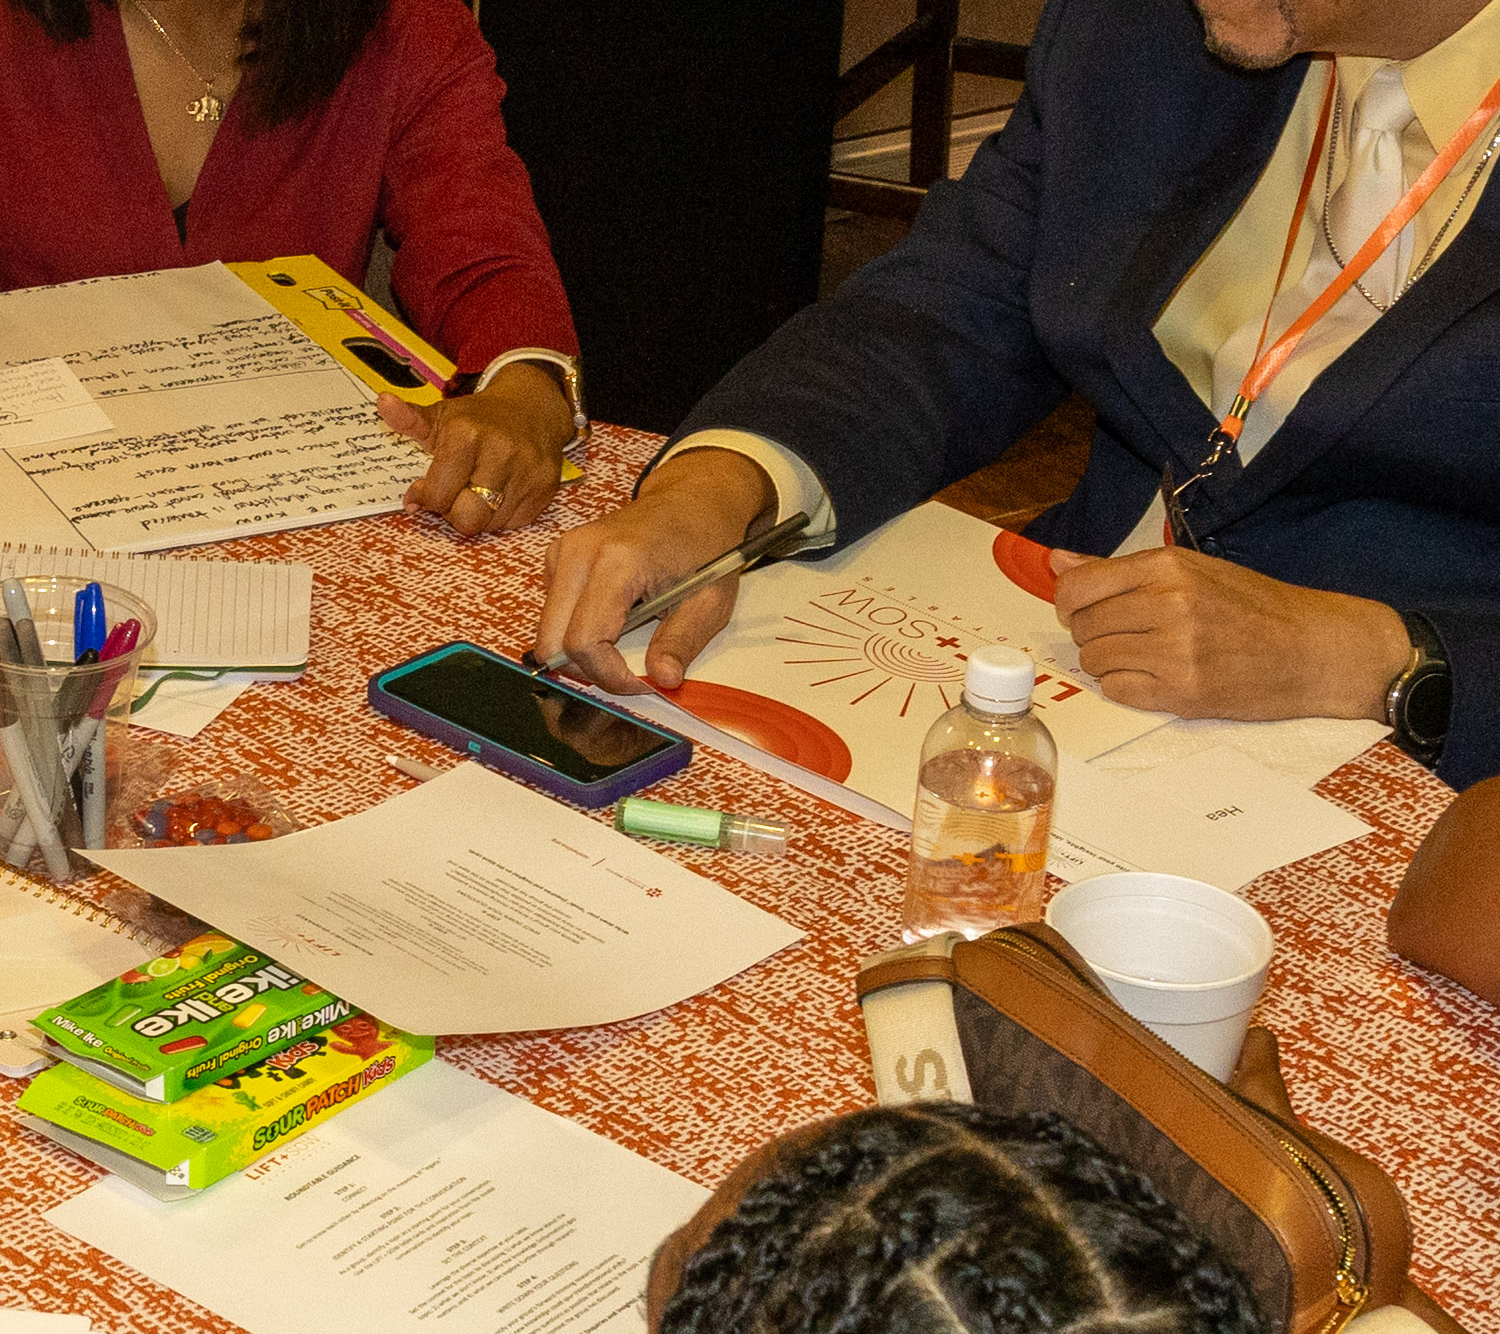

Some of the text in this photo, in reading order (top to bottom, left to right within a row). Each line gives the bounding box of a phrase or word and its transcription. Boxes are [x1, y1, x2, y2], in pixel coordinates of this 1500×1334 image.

[164, 954, 258, 1001] Original Fruits
[214, 963, 299, 1005] ike
[51, 1015, 104, 1049] Mike Ike
[130, 997, 220, 1037] Ike
[266, 1018, 298, 1045] Ike
[218, 1035, 262, 1063] Original
[267, 1039, 319, 1074] Kids
[184, 1057, 216, 1078] Fruits
[73, 1095, 106, 1116] SOUR
[252, 1054, 397, 1151] SOUR PATCH Kids
[284, 1151, 361, 1203] ROUNDTABLE GUIDANCE
[333, 1184, 350, 1197] STEP
